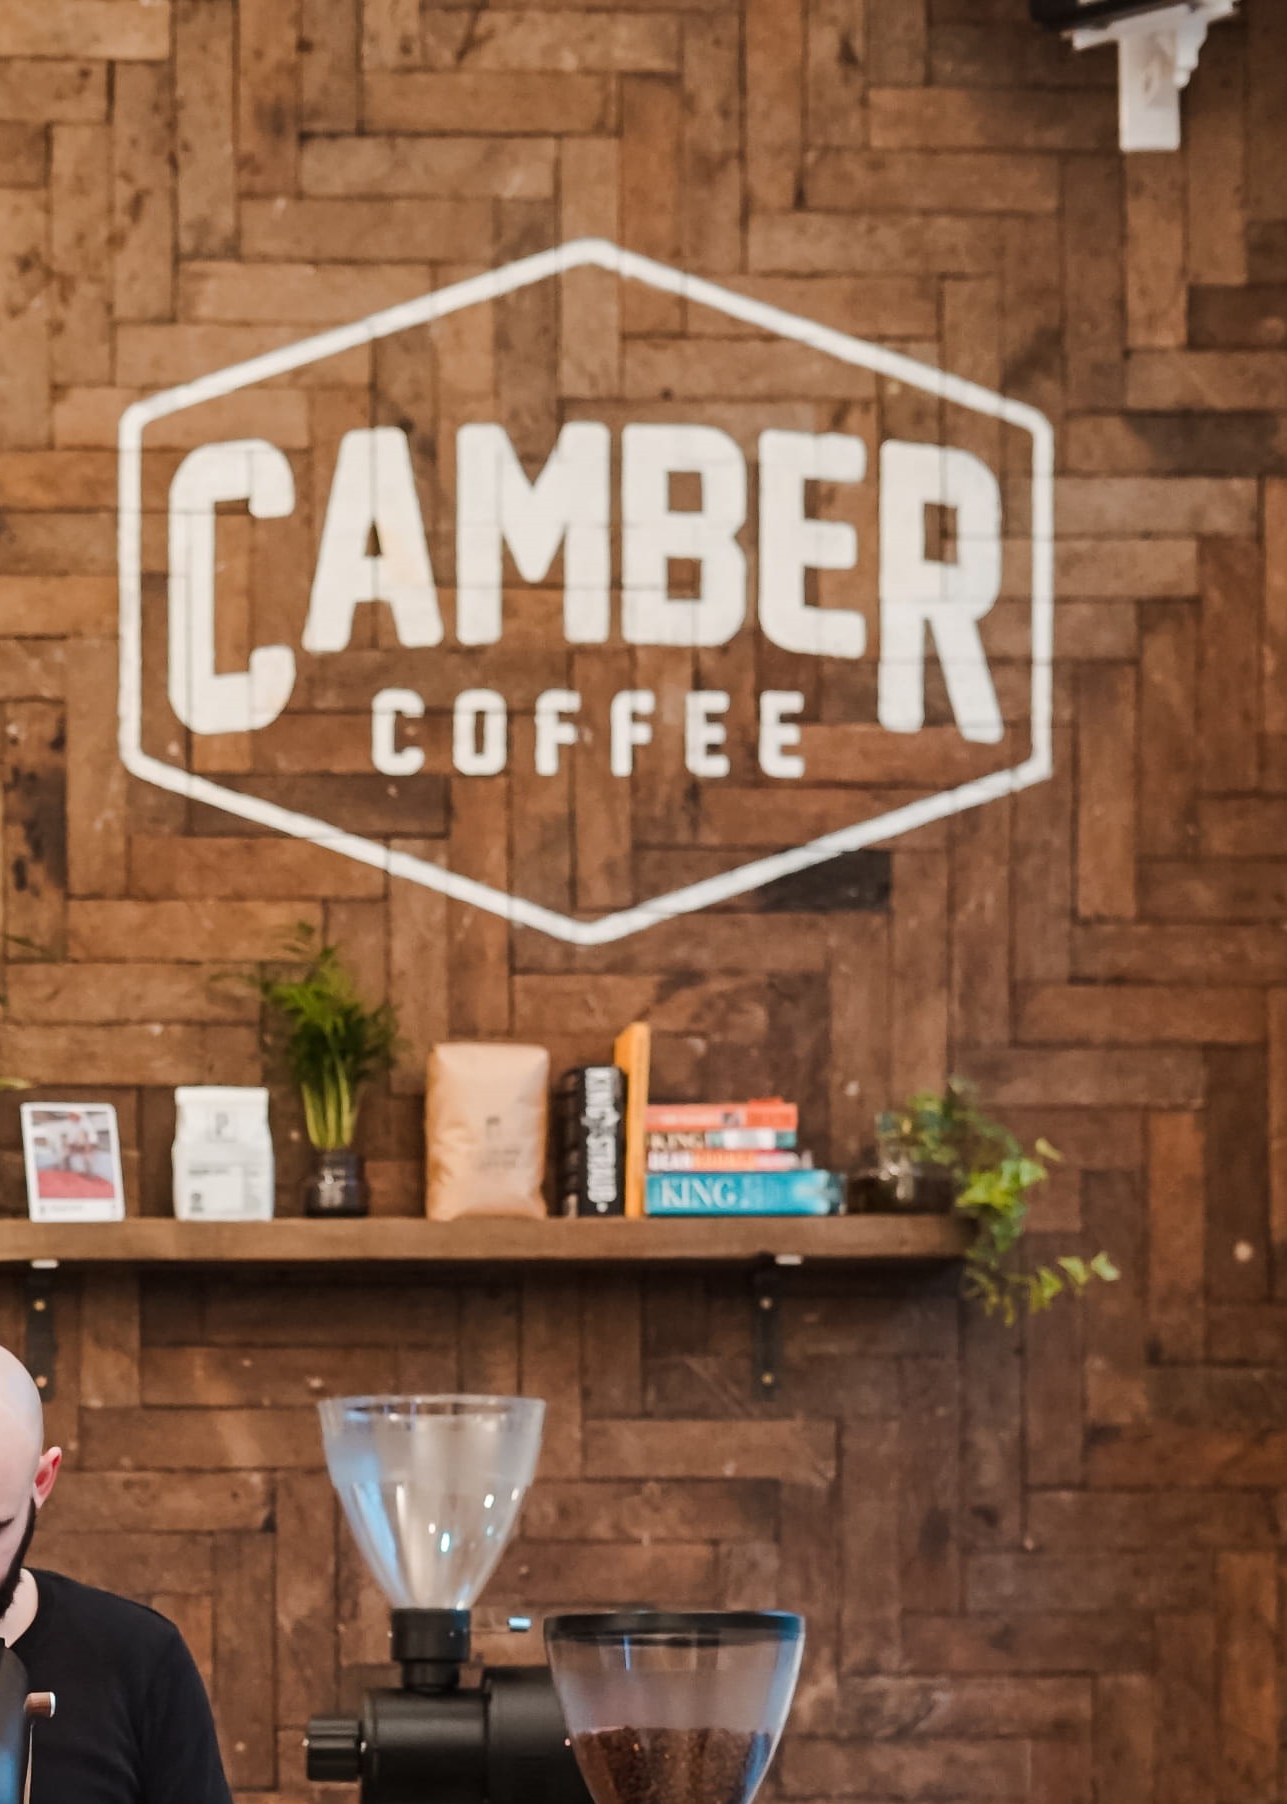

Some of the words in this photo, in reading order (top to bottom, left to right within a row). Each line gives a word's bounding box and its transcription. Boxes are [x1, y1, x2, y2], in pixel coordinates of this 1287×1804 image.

[169, 421, 1005, 744] CAMBER
[370, 687, 806, 779] COFFEE
[659, 1178, 738, 1209] KING
